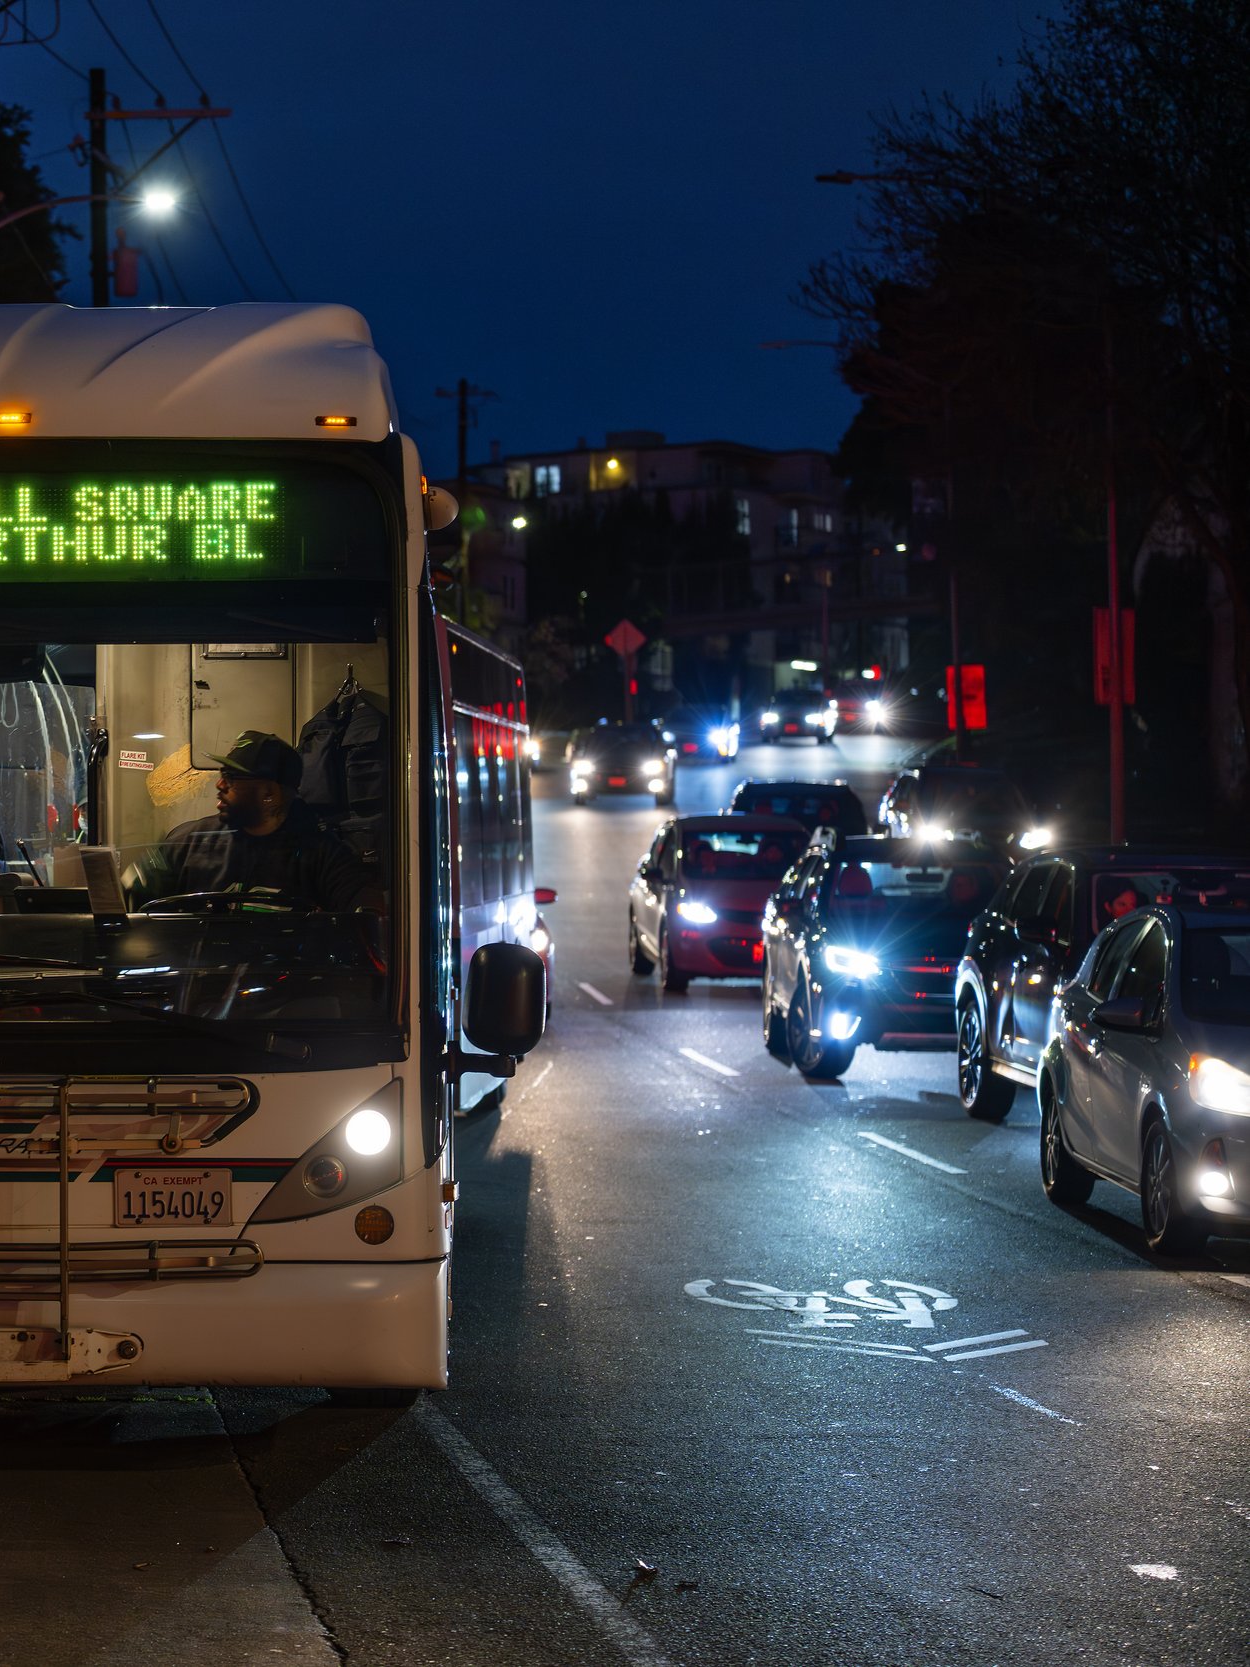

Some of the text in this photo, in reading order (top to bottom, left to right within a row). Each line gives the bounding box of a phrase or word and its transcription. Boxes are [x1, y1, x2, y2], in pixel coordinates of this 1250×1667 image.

[73, 481, 277, 522] SQUARE
[195, 522, 265, 560] BL
[143, 1176, 204, 1186] CA EXEMPT
[122, 1190, 225, 1219] 1154049
